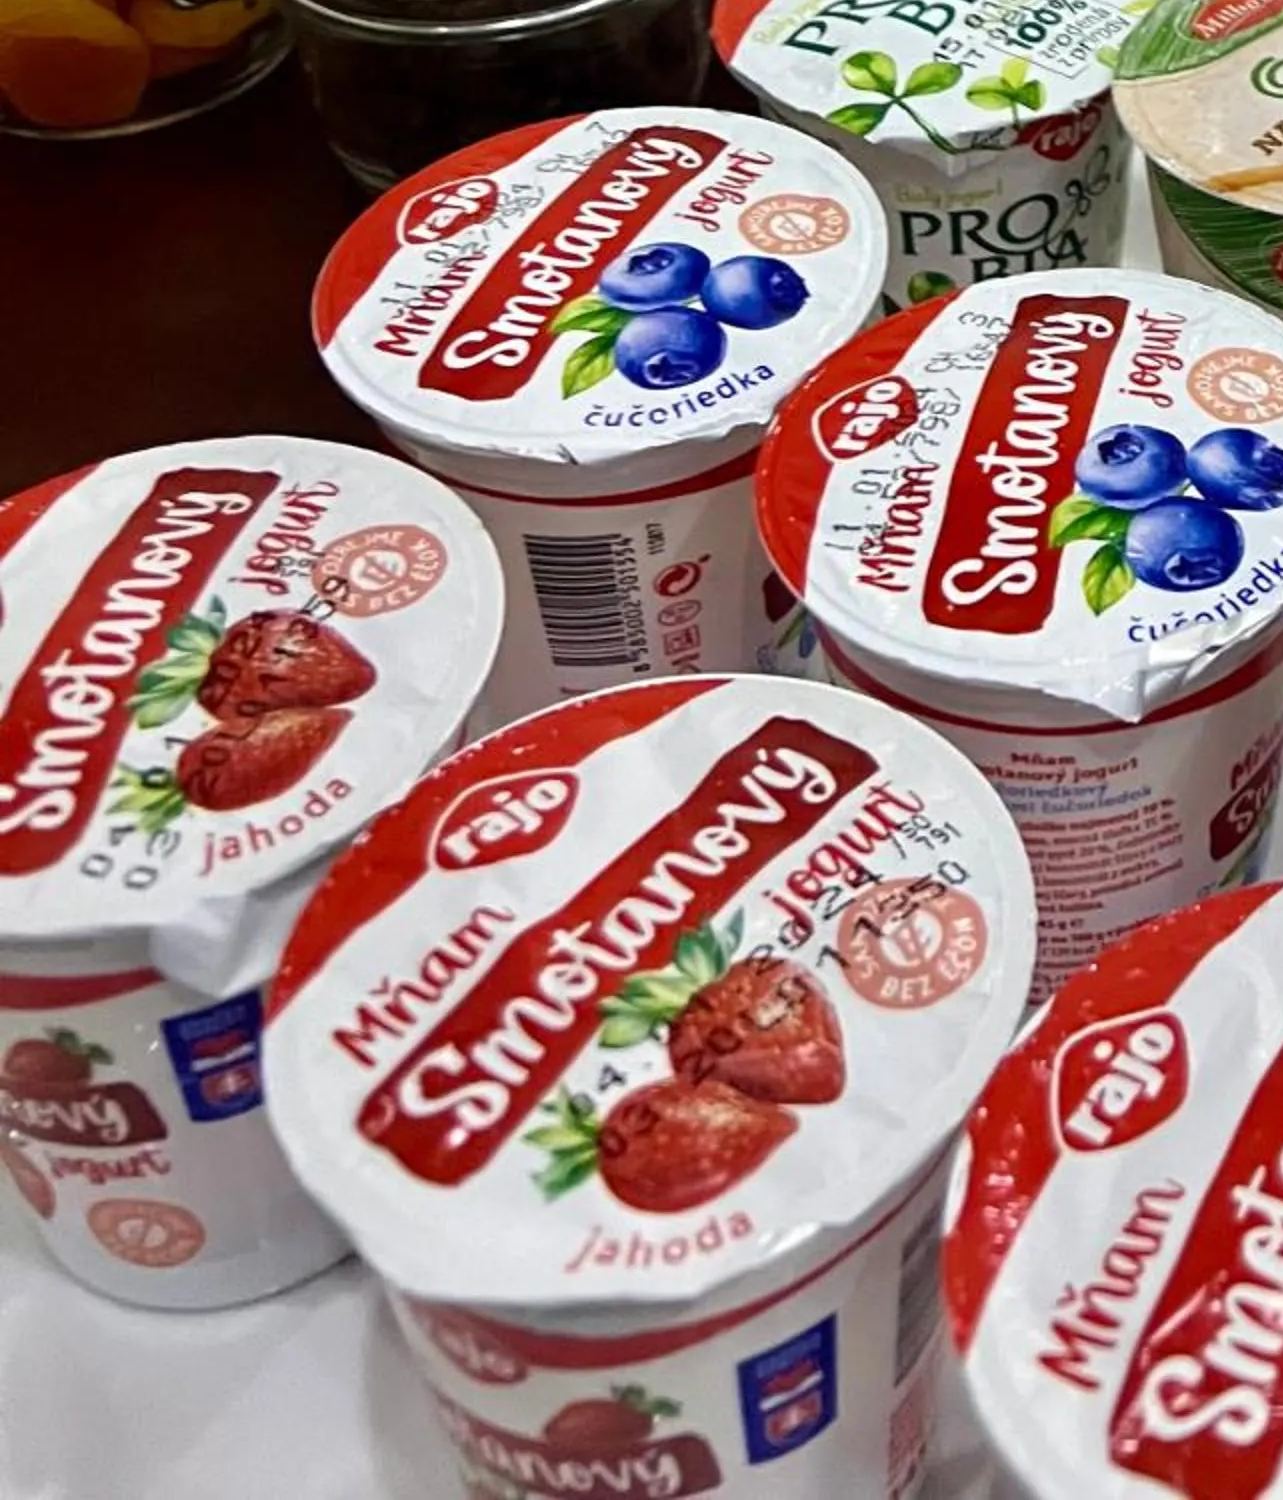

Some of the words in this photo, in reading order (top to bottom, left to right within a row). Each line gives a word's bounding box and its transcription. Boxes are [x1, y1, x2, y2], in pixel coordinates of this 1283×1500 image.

[408, 179, 494, 241] rajo
[674, 146, 775, 232] jogurt
[899, 193, 1060, 256] PRO
[373, 250, 489, 358] Mňam
[443, 137, 702, 369] Smotanový
[584, 361, 777, 428] čučoriedka
[1118, 306, 1187, 410] jogurt
[832, 381, 903, 452] rajo
[941, 307, 1115, 608] Smotanový
[228, 480, 340, 595] jogurt
[200, 775, 354, 877] jahoda
[441, 778, 571, 863] rajo
[761, 780, 925, 950] jogurt
[330, 898, 522, 1071] Mňam
[399, 742, 840, 1132] Smotanový
[1060, 1020, 1177, 1147] rajo
[562, 1211, 756, 1273] jahoda
[1036, 1177, 1186, 1392] Mňam
